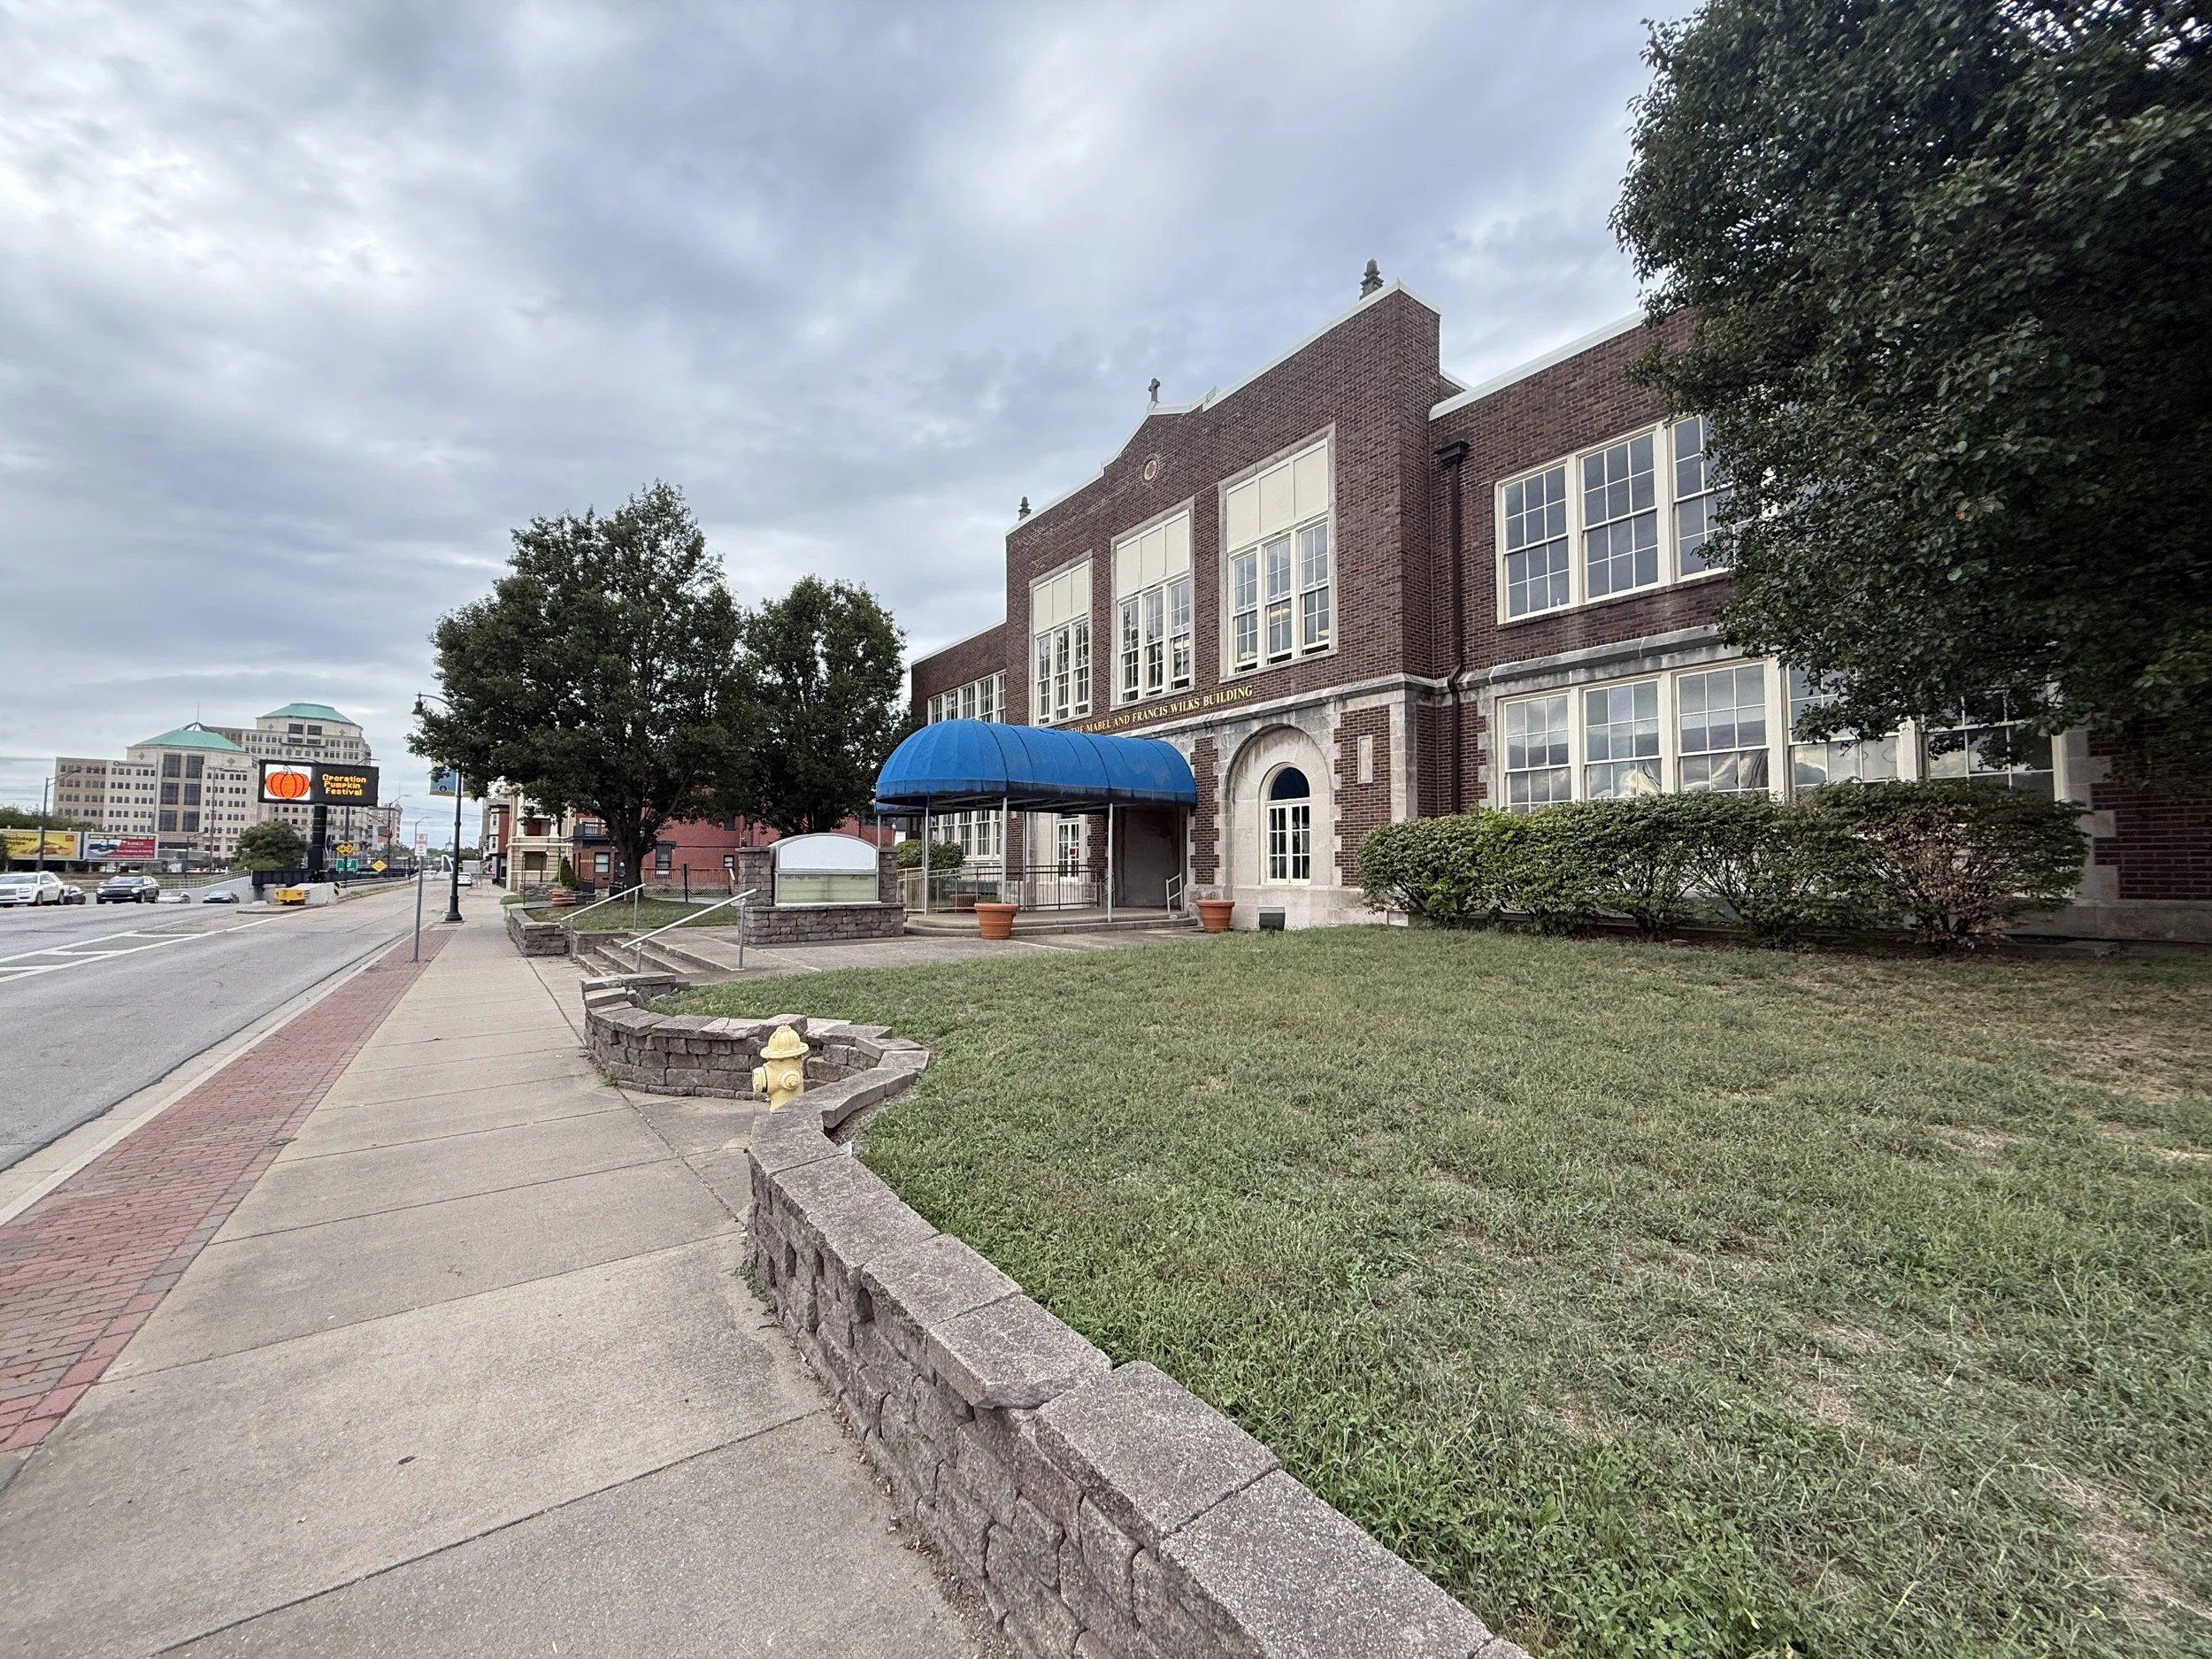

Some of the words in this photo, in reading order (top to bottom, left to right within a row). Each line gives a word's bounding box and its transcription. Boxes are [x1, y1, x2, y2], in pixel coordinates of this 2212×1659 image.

[1086, 719, 1111, 733] MABEL
[1113, 714, 1130, 727] AND
[1132, 704, 1168, 723] FRANCIS
[1169, 698, 1200, 714] WILKS
[1202, 685, 1253, 705] BUILDING
[322, 773, 366, 782] Operation
